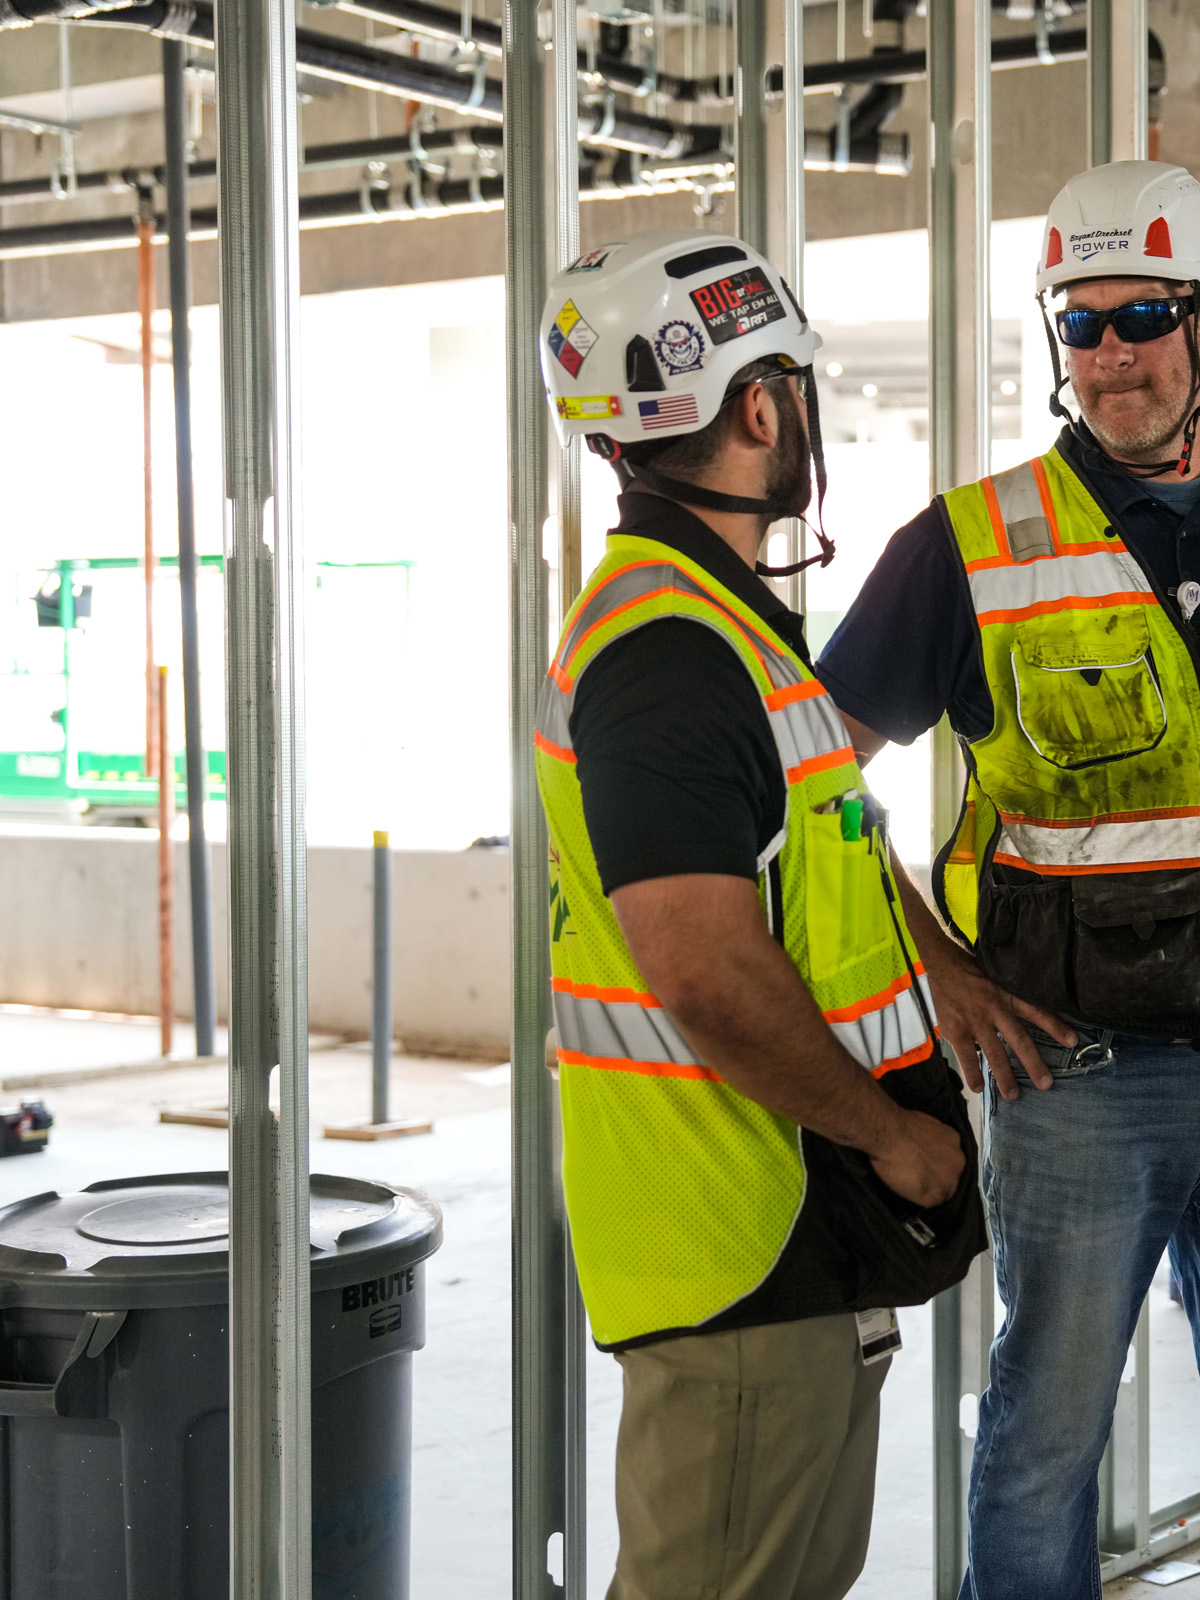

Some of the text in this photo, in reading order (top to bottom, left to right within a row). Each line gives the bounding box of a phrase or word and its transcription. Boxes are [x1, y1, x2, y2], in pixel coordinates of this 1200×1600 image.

[1070, 231, 1096, 242] Bryant
[1072, 240, 1129, 253] POWER
[693, 278, 742, 319] BIG
[708, 293, 779, 327] WE TAP EM ALL
[342, 1267, 415, 1313] BRUTE
